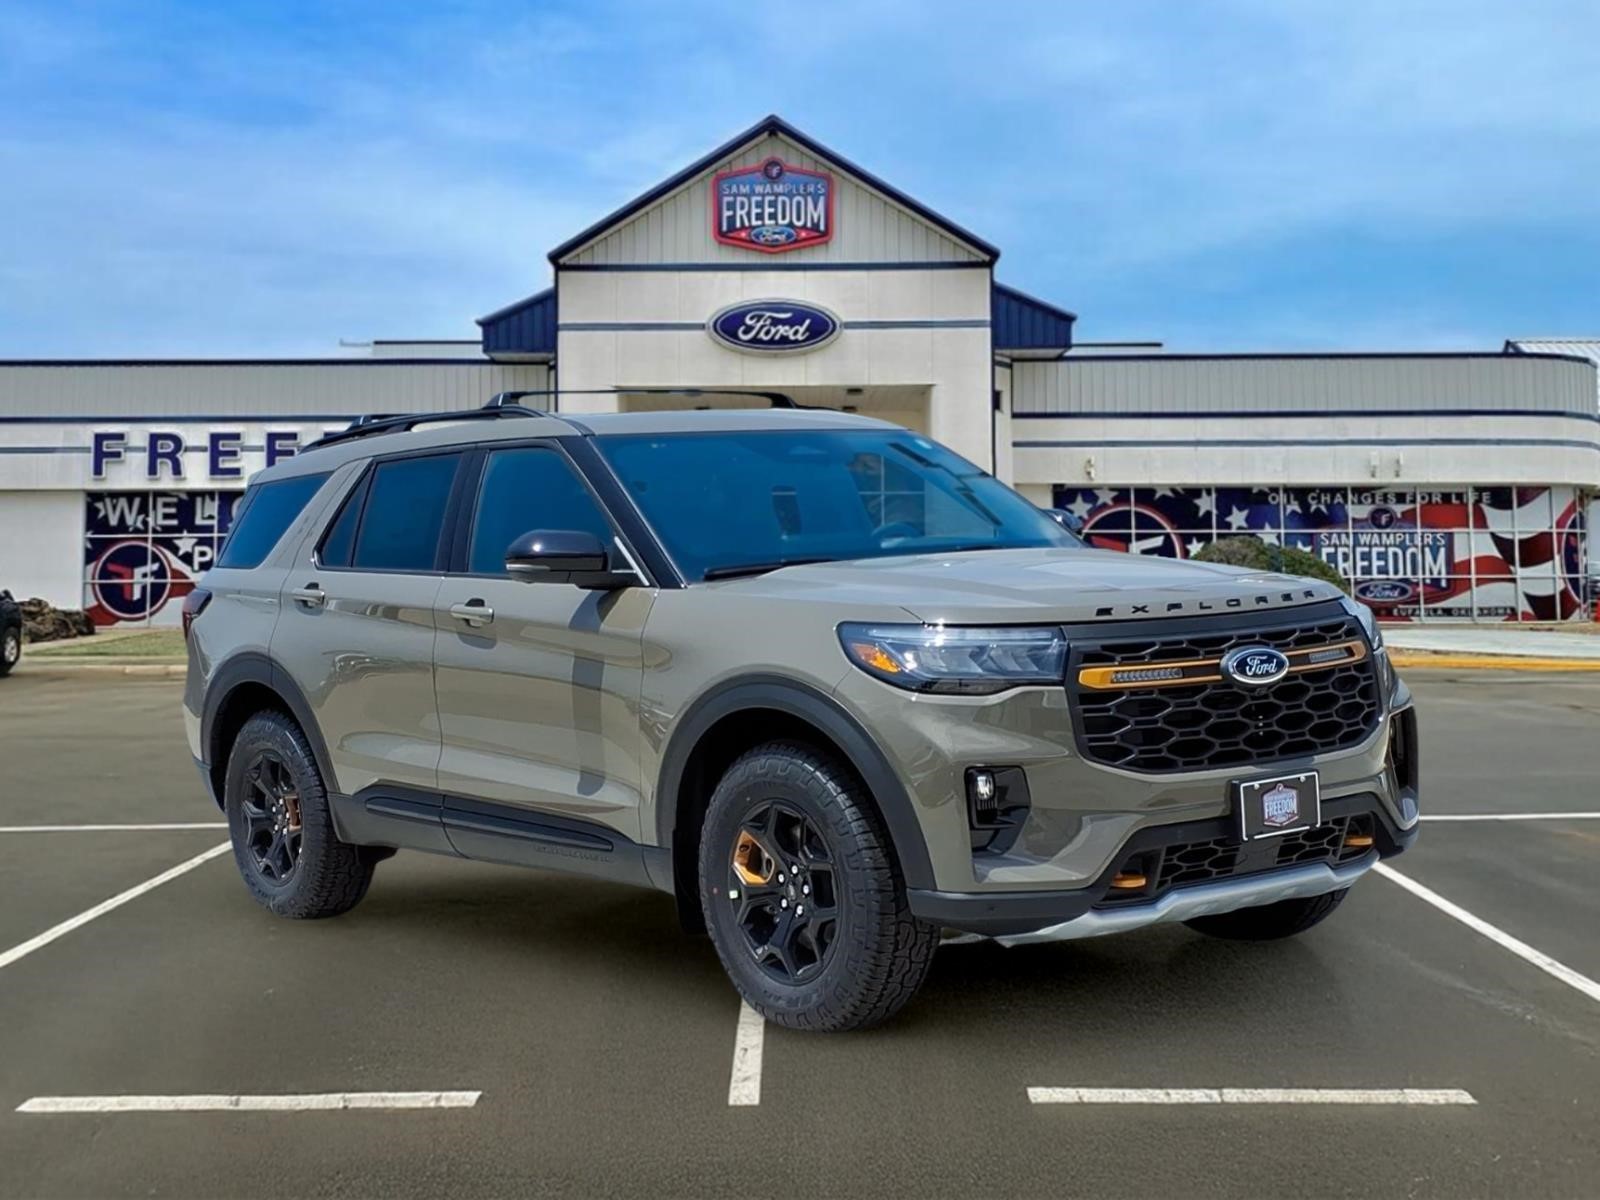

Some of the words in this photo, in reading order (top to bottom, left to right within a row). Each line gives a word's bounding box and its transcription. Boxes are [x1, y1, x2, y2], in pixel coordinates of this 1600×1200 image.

[722, 184, 750, 194] SAM
[722, 195, 826, 232] FREEDOM
[738, 310, 811, 342] Ford
[92, 431, 346, 480] FREE
[1267, 492, 1299, 505] OIL
[1307, 492, 1397, 505] CHANGES
[1405, 492, 1443, 504] FOR
[1451, 491, 1492, 504] LIFE
[1321, 546, 1447, 588] FREEDOM
[1096, 590, 1315, 617] EXPLORER
[1365, 583, 1400, 598] Ford
[1245, 655, 1278, 676] Ford
